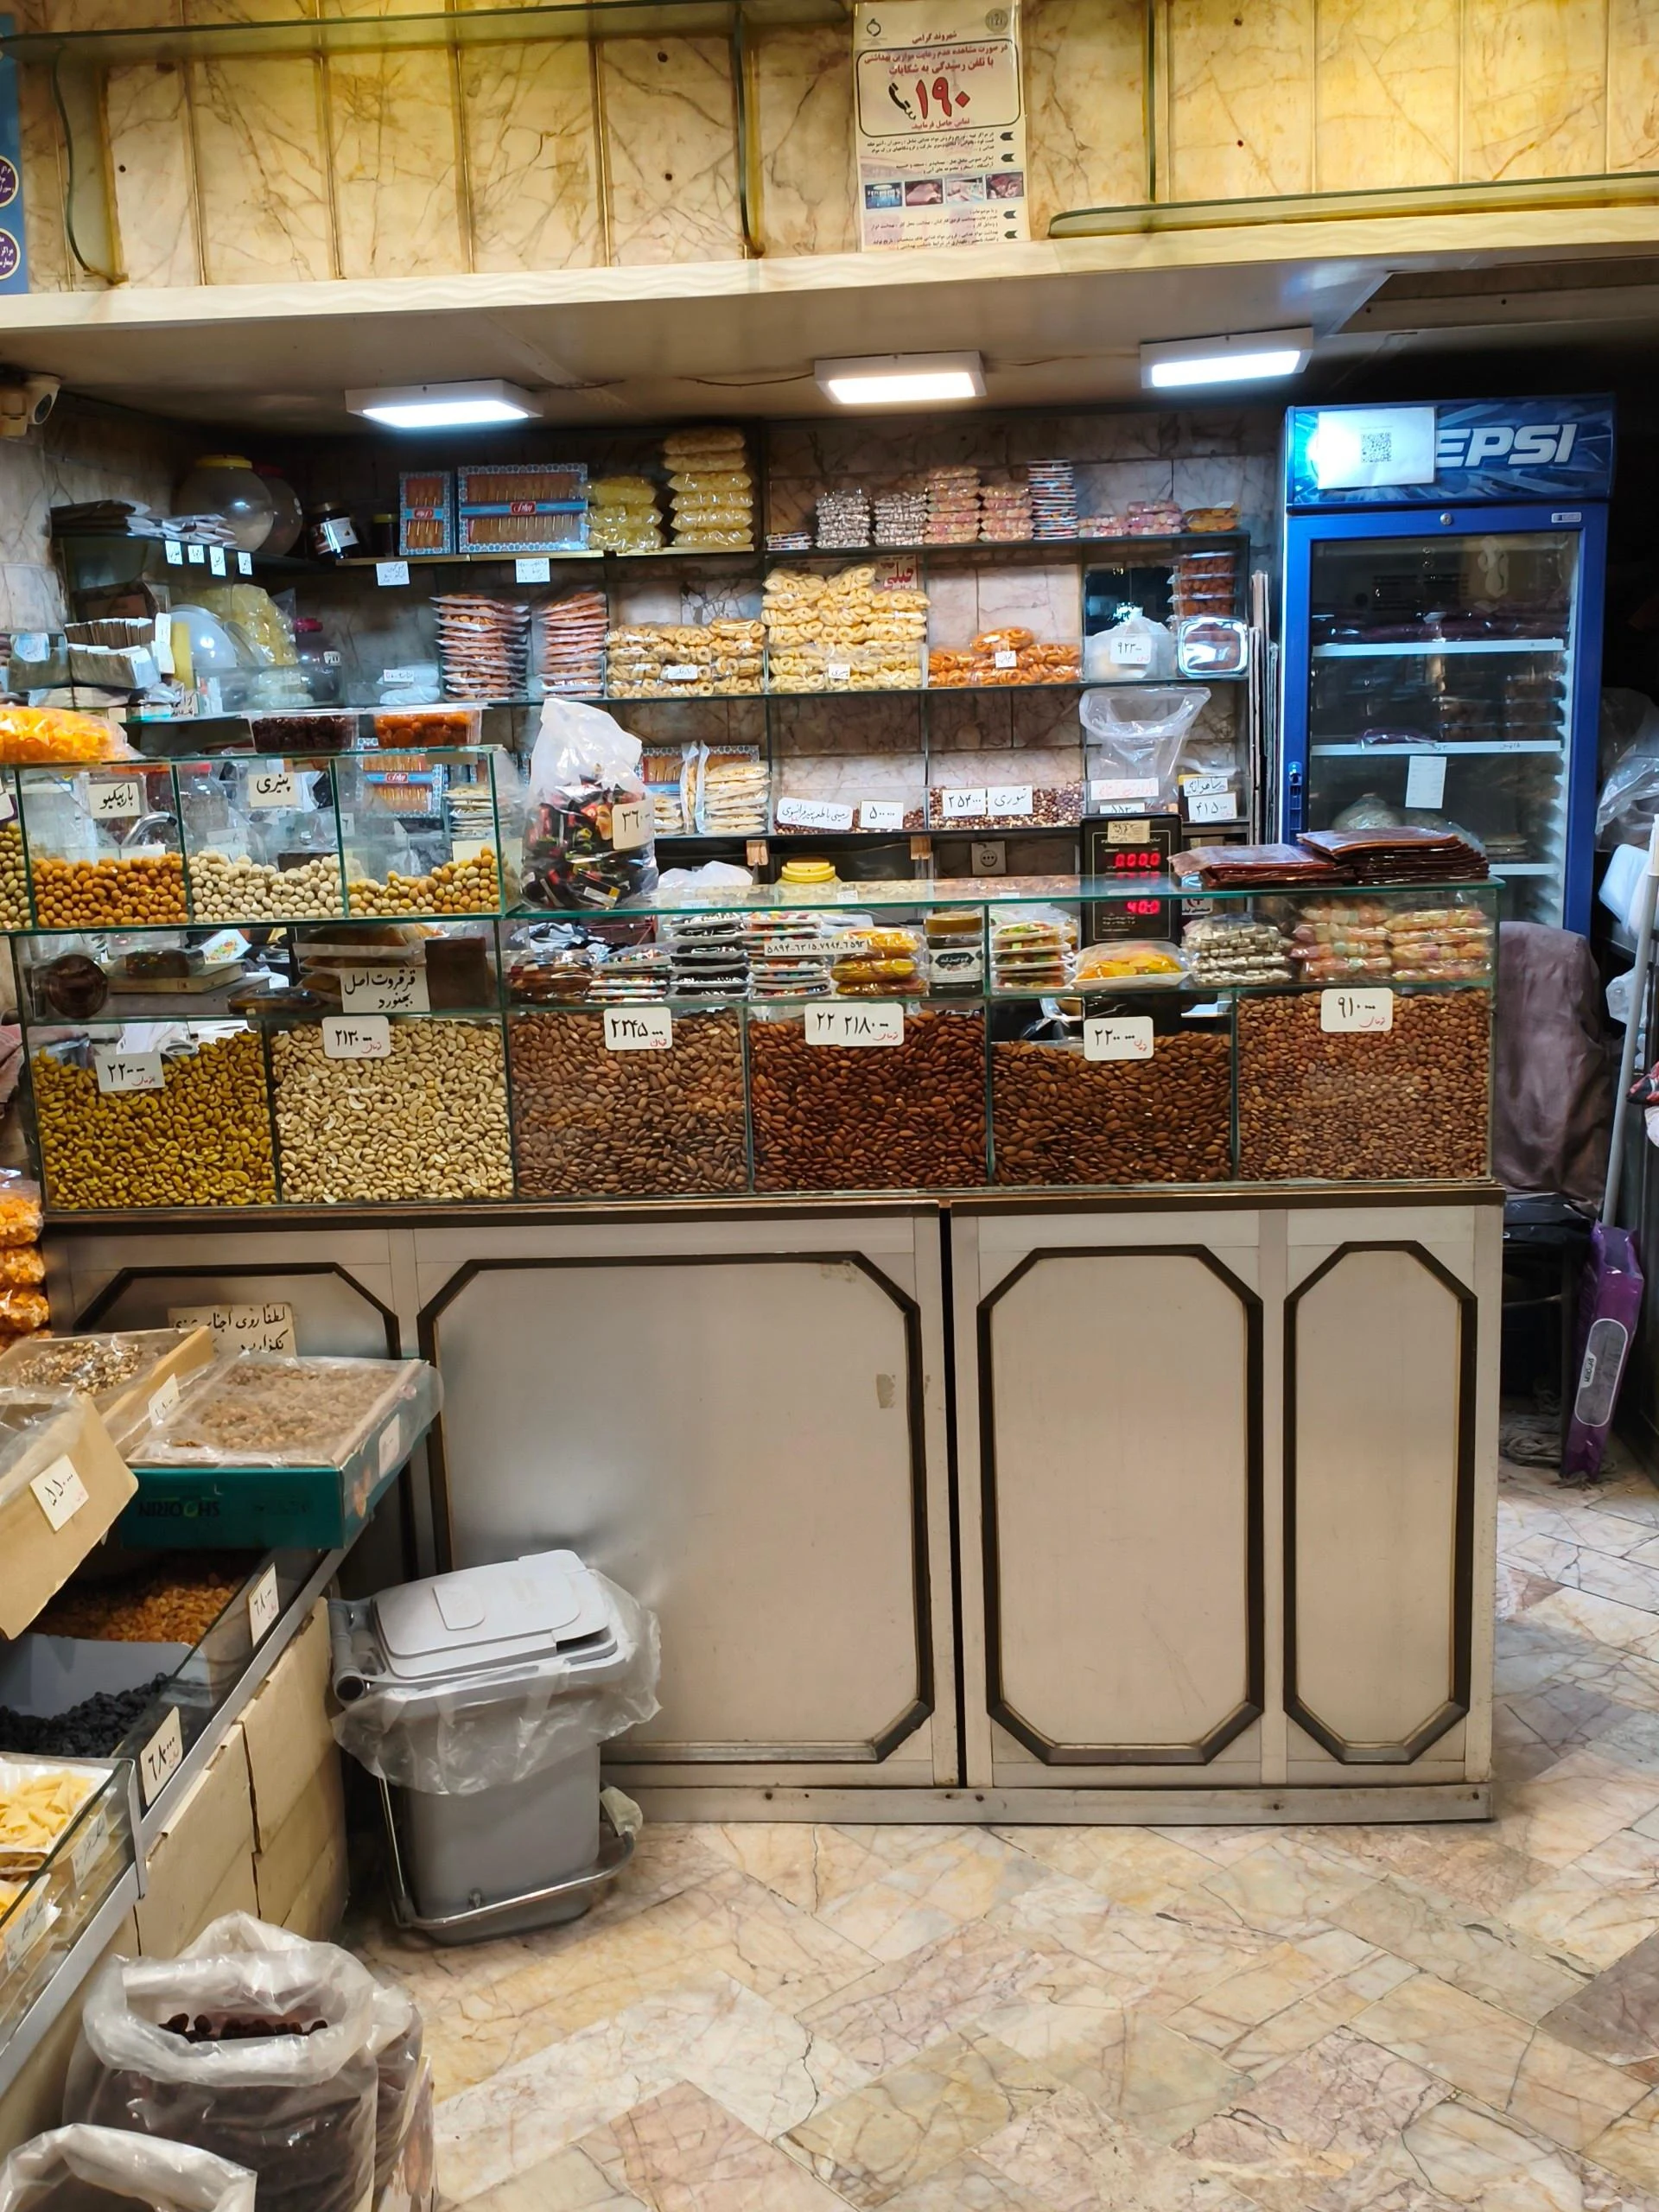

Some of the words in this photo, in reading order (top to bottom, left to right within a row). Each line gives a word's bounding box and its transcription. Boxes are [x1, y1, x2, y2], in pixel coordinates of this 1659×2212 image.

[915, 76, 971, 120] ۱۹۰
[1435, 423, 1578, 468] EPSI
[257, 772, 290, 793] پنیری
[345, 970, 370, 995] اصل
[372, 969, 416, 992] قرقروت
[378, 992, 413, 1009] بجنورد
[207, 1311, 232, 1332] اجنا
